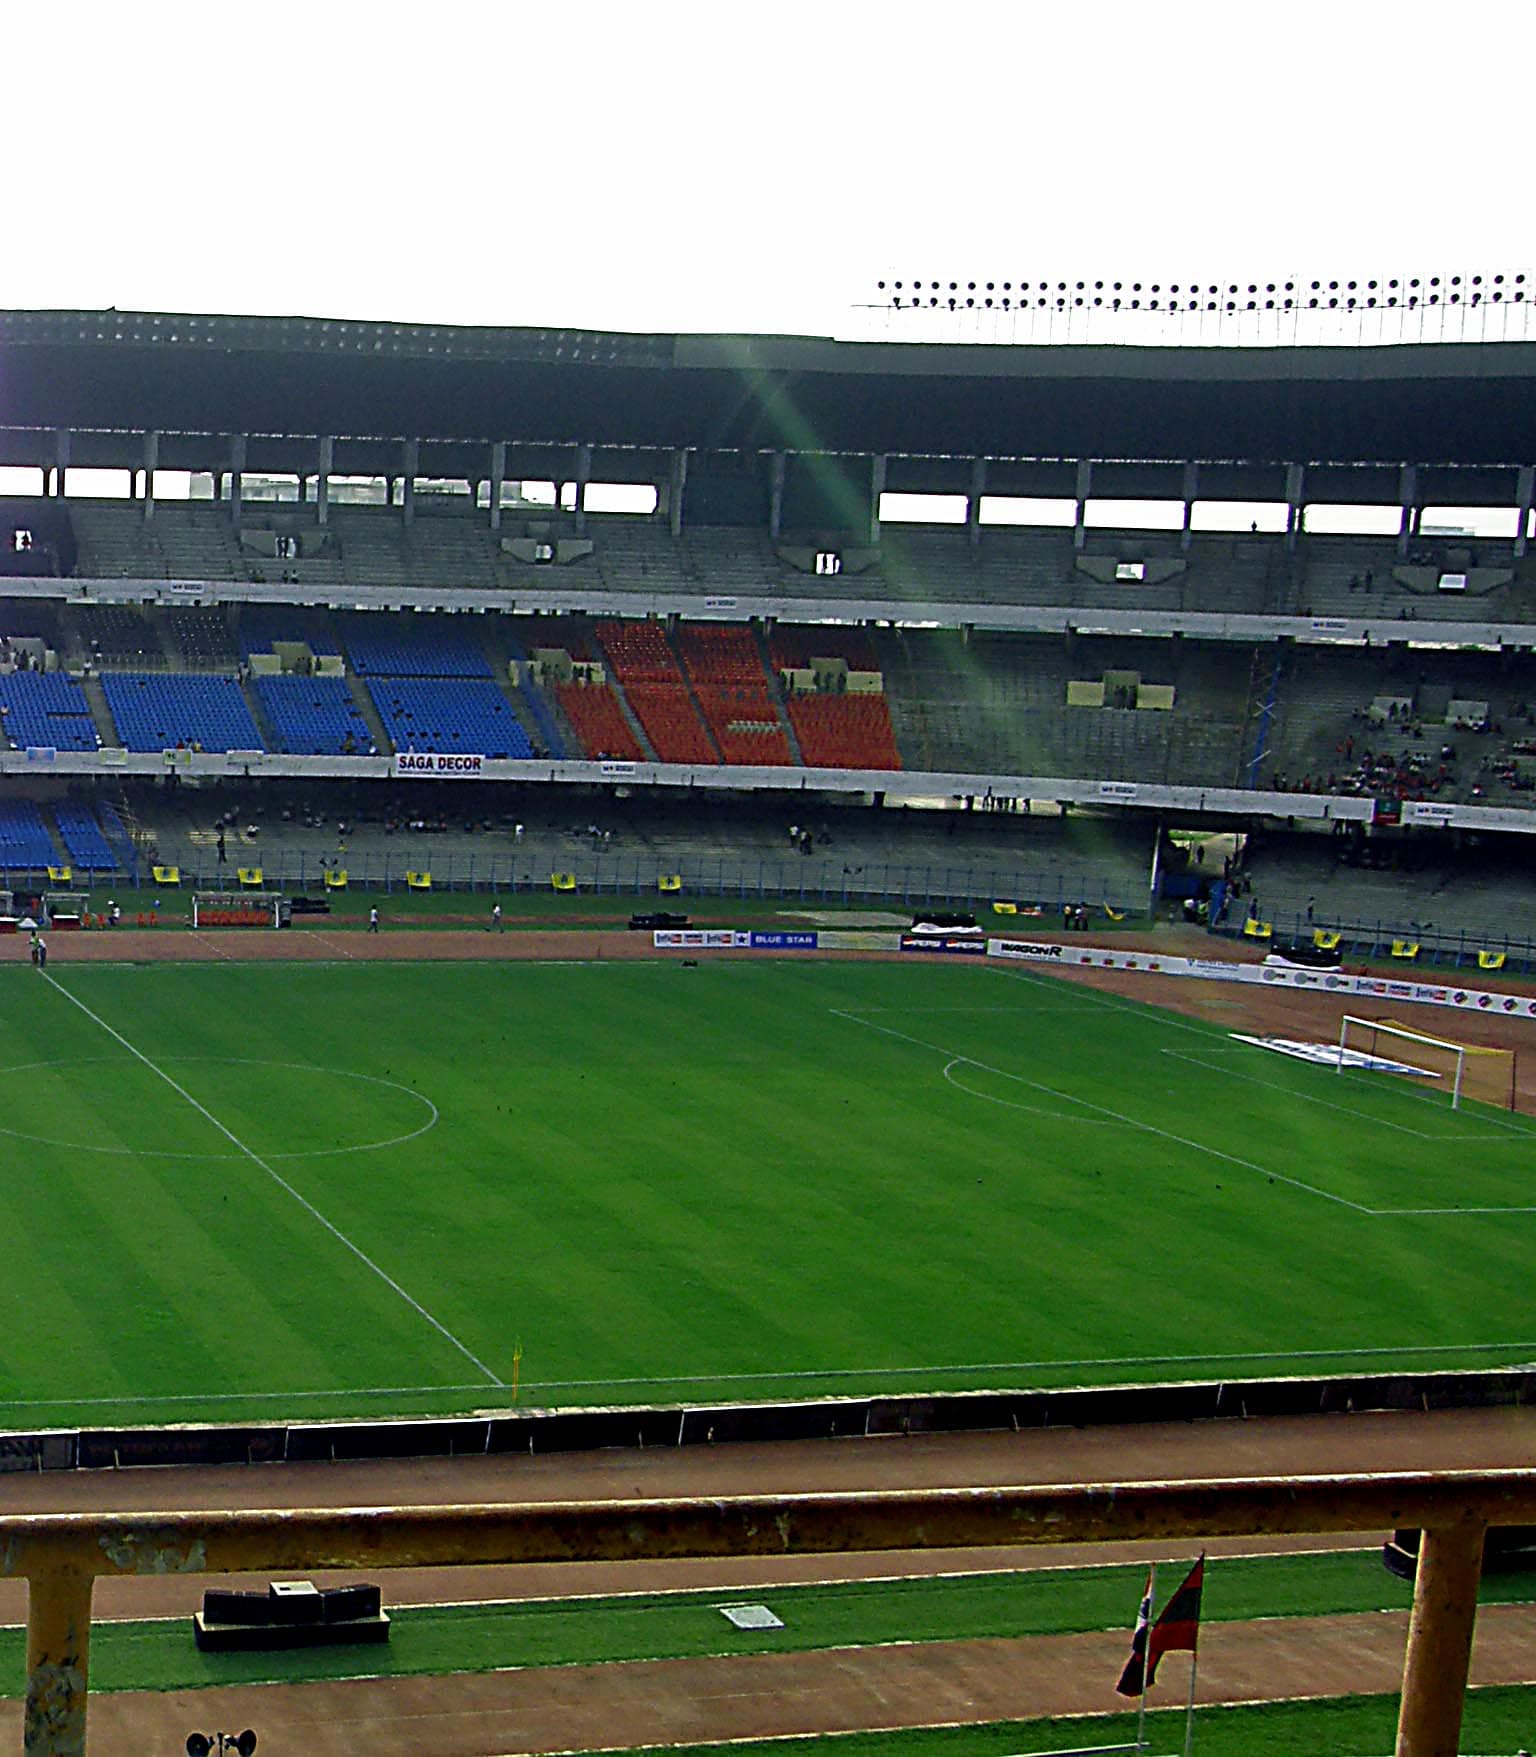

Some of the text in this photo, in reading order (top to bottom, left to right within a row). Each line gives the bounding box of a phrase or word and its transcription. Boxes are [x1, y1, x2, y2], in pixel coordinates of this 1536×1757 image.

[399, 756, 481, 769] SAGA DECOR
[754, 935, 812, 944] BLUE STAR
